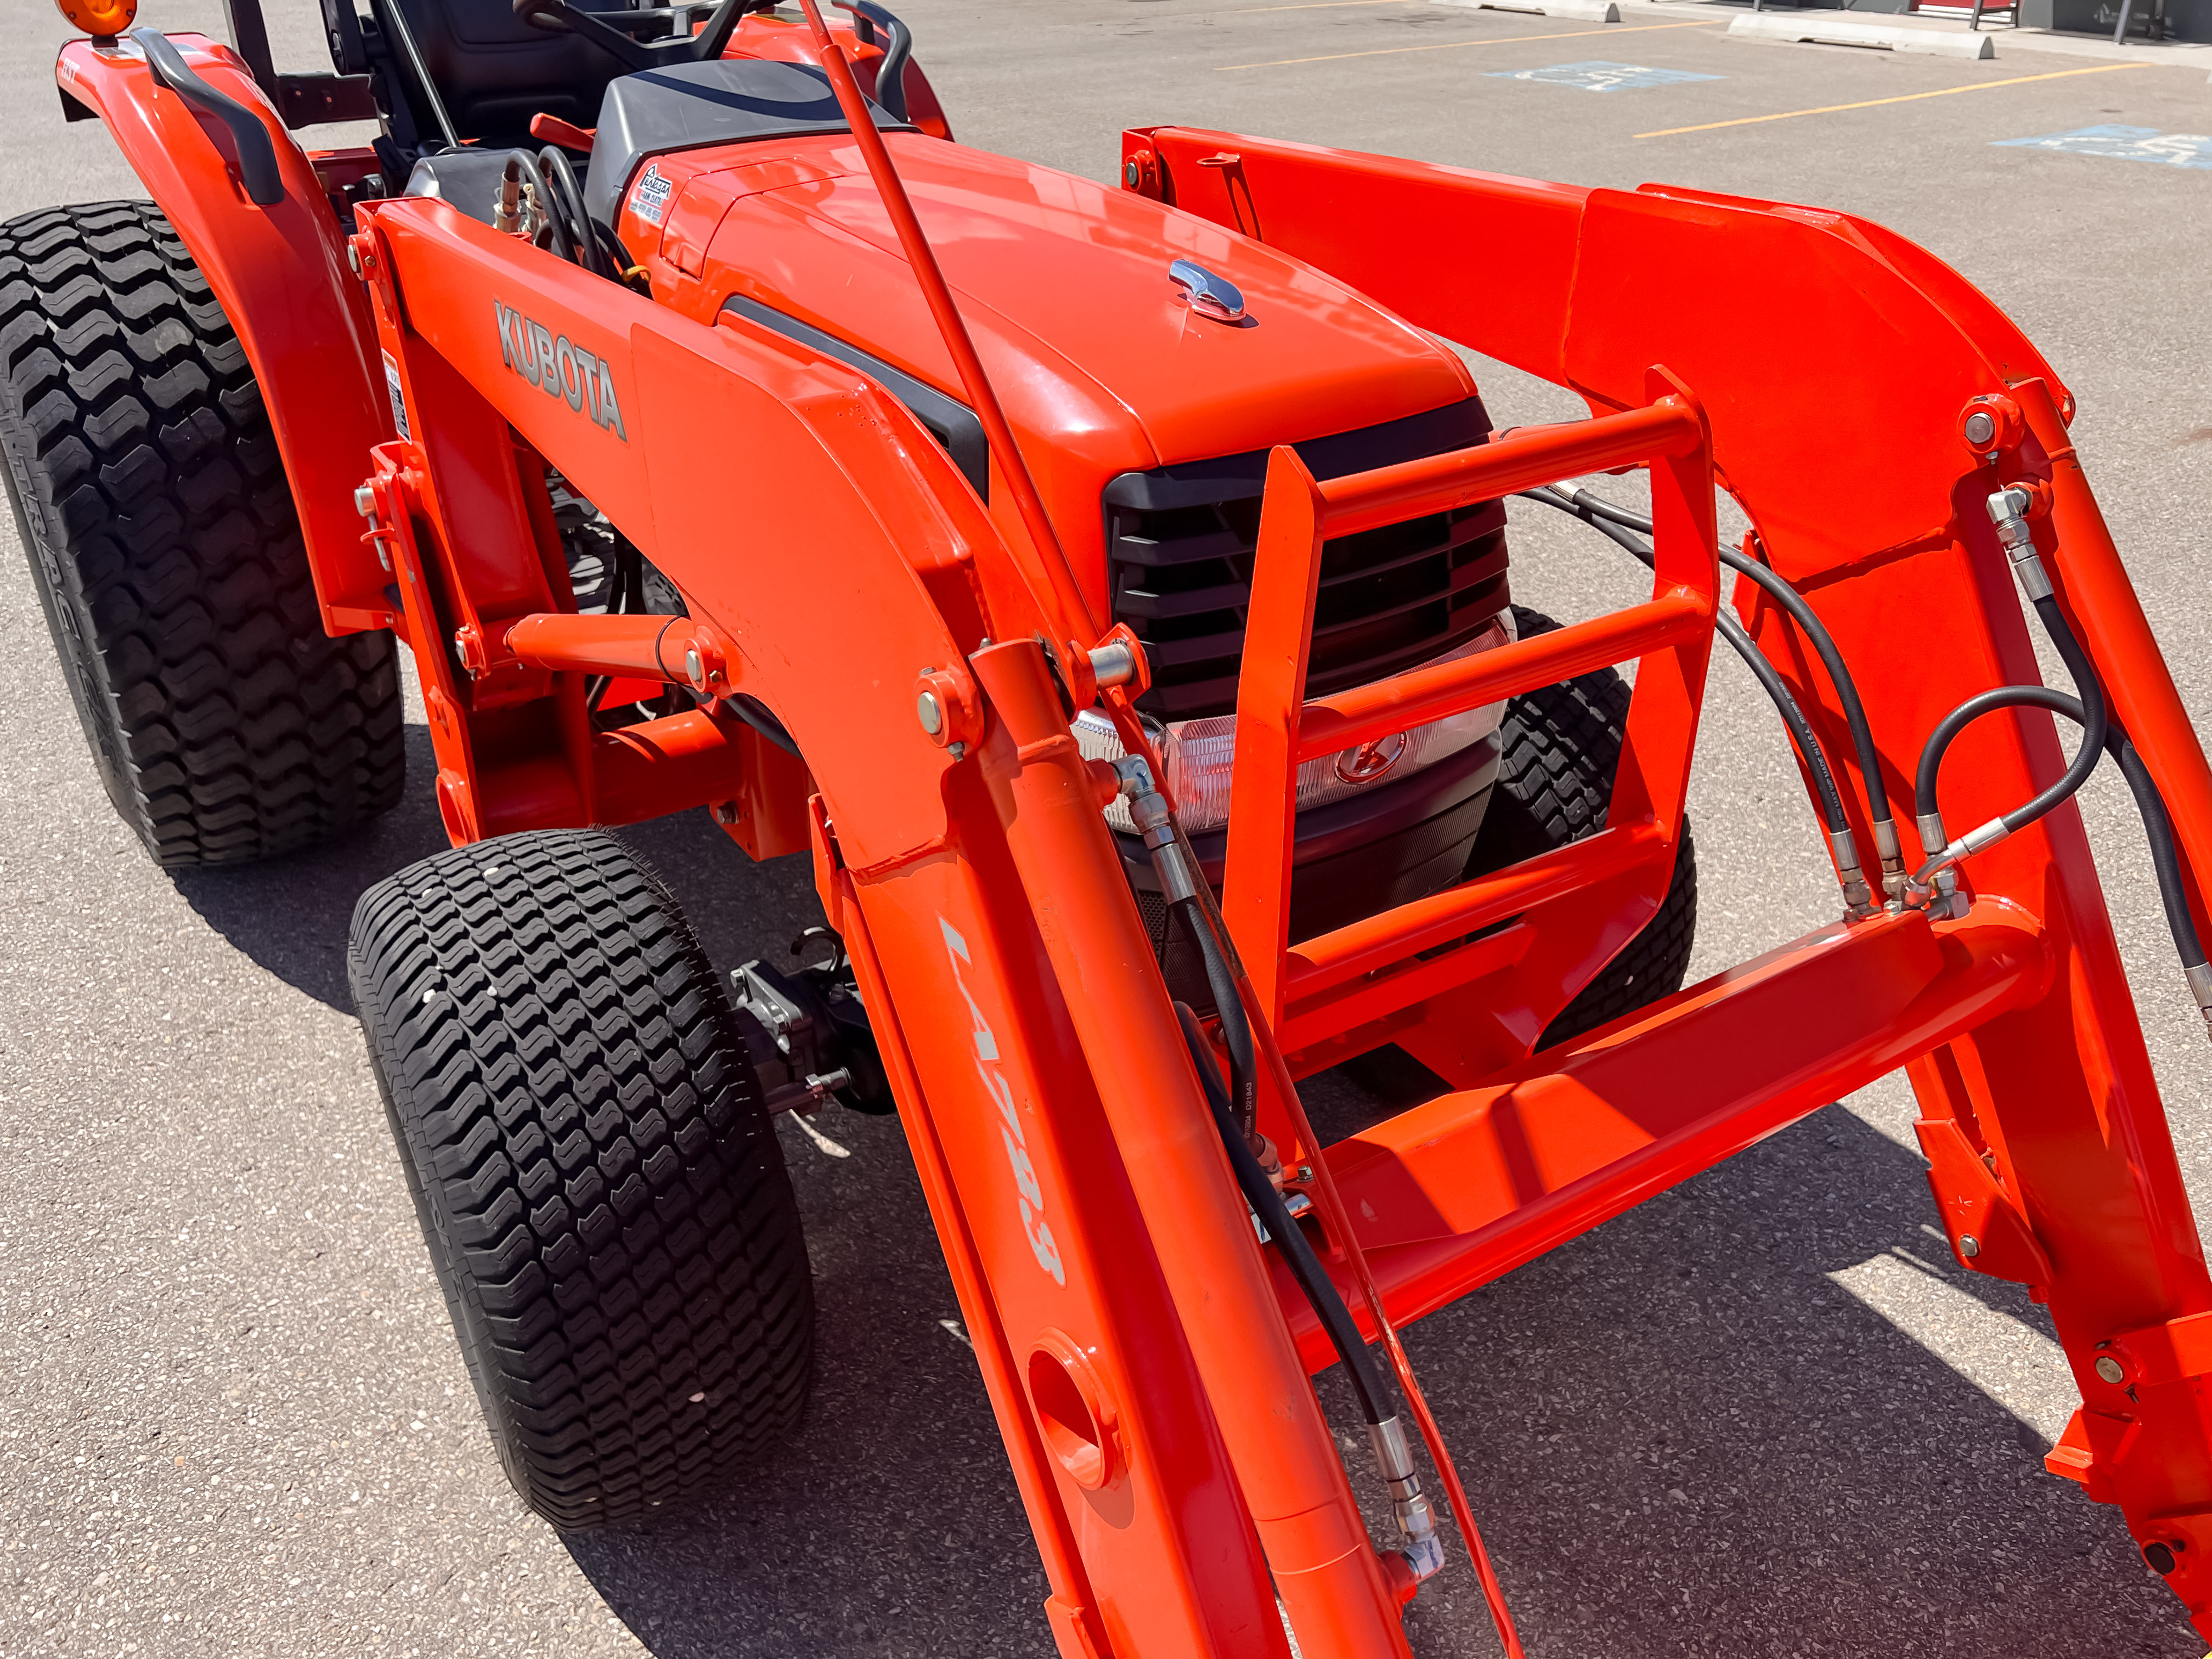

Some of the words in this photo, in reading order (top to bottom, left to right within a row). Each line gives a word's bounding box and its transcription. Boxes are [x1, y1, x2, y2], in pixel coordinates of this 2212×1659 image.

[494, 298, 628, 443] KUBOTA
[13, 453, 81, 641] TRAC
[1814, 747, 1821, 756] IN
[1817, 757, 1830, 777] MADE
[1831, 791, 1840, 807] MAX
[939, 914, 1067, 1288] LA723
